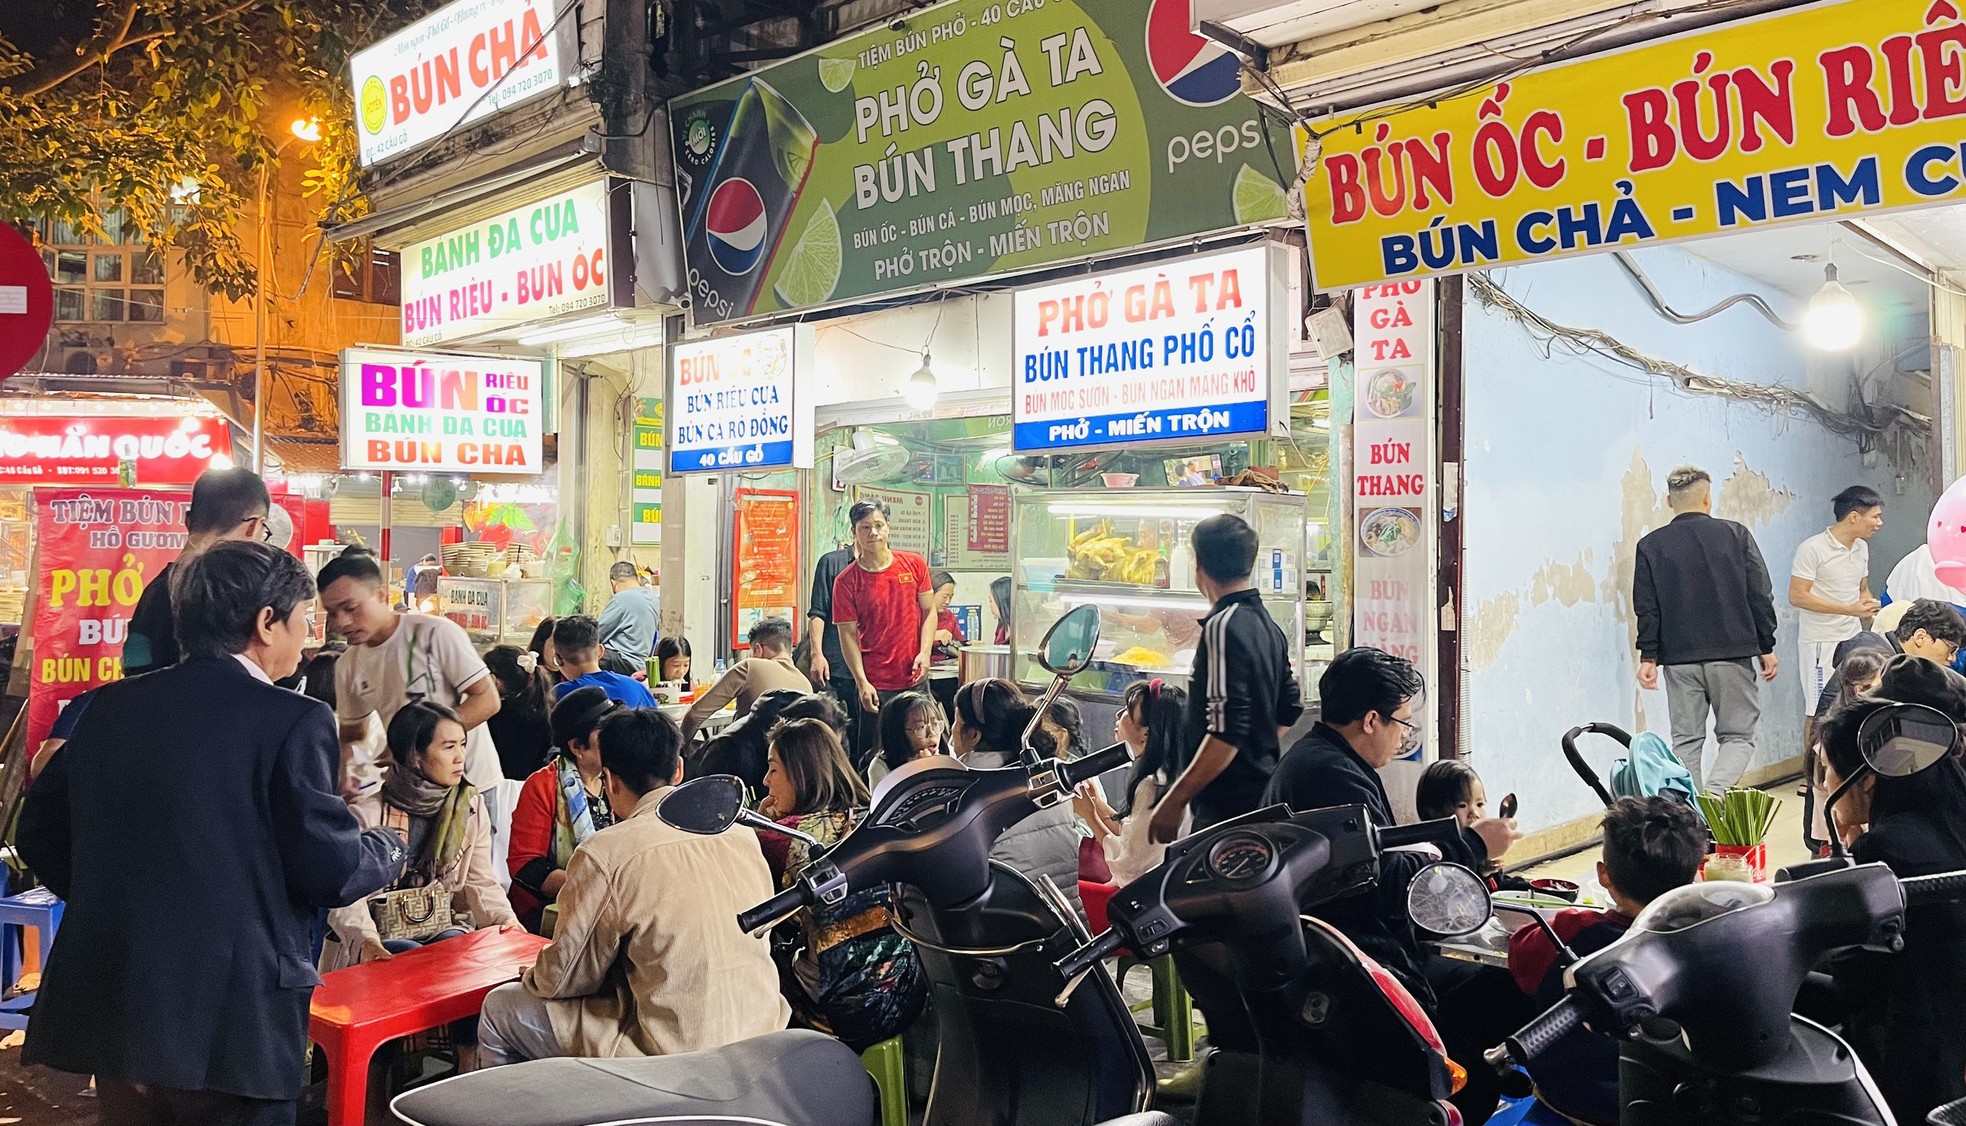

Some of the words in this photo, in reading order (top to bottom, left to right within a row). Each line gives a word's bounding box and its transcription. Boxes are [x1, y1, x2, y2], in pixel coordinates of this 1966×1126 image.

[858, 44, 891, 70] TIỆM
[896, 31, 927, 57] BÚN
[932, 11, 967, 43] PHỞ
[981, 4, 1001, 25] 40
[390, 47, 462, 126] BÚN
[468, 0, 549, 89] CHẢ
[502, 85, 517, 100] 094
[518, 79, 532, 94] 720
[533, 68, 553, 90] 3070
[854, 60, 944, 143] PHỞ
[956, 36, 1031, 111] GÀ
[1041, 26, 1103, 88] TA
[1324, 122, 1454, 226] BÚN
[1472, 82, 1566, 198] ỐC
[1623, 50, 1794, 173] BÚN
[854, 142, 936, 210] BÚN
[945, 99, 1118, 186] THANG
[853, 227, 877, 249] BÚN
[881, 220, 897, 243] ỐC
[909, 214, 935, 237] BÚN
[938, 207, 956, 230] CÁ
[969, 199, 996, 223] BÚN
[1000, 192, 1038, 217] MỌC,
[1041, 181, 1084, 207] MĂNG
[1088, 170, 1130, 197] NGAN
[1381, 215, 1500, 277] BÚN
[1514, 180, 1656, 252] CHẢ
[1715, 157, 1881, 227] NEM
[1905, 141, 1966, 196] C
[421, 235, 480, 280] BÁNH
[487, 217, 522, 260] ĐA
[530, 198, 579, 246] CUA
[874, 246, 914, 280] PHỞ
[919, 239, 972, 273] TRỘN
[989, 218, 1041, 257] MIẾN
[1047, 210, 1109, 247] TRỘN
[404, 291, 442, 334] BÚN
[449, 276, 493, 322] RIÊU
[517, 257, 563, 306] BÚN
[572, 240, 604, 291] ỐC
[1038, 280, 1113, 337] PHỞ
[1124, 273, 1175, 323] GÀ
[1188, 269, 1242, 314] TA
[549, 305, 561, 316] Tel:
[561, 301, 575, 313] 094
[575, 297, 588, 310] 720
[589, 293, 606, 306] 3070
[1370, 300, 1413, 329] GÀ
[1025, 346, 1068, 383] BÚN
[1077, 338, 1153, 376] THANG
[1164, 317, 1214, 366] PHỐ
[1225, 310, 1256, 359] CỔ
[1371, 338, 1412, 360] TA
[485, 372, 529, 390] RIÊU
[680, 350, 720, 386] BÚN
[362, 360, 478, 411] BÚN
[687, 389, 712, 413] BÚN
[717, 385, 747, 410] RIÊU
[751, 385, 779, 405] CUA
[1025, 389, 1047, 414] BÚN
[1150, 378, 1184, 401] NGAN
[1233, 365, 1255, 393] KHÔ
[486, 392, 529, 414] ỐC
[365, 410, 433, 434] BÁNH
[443, 416, 474, 436] ĐA
[483, 417, 527, 438] CUA
[678, 420, 703, 444] BÚN
[750, 407, 788, 437] ĐỒNG
[1048, 417, 1090, 441] PHỞ
[1108, 411, 1161, 437] MIẾN
[1167, 408, 1230, 433] TRỘN
[368, 437, 442, 463] BÚN
[456, 438, 526, 465] CHẢ
[699, 453, 715, 467] 40
[1370, 438, 1410, 464] BÚN
[92, 466, 107, 475] 520
[635, 473, 661, 487] BÁNH
[1357, 474, 1424, 496] THANG
[50, 493, 113, 529] TIỆM
[119, 495, 174, 525] BÚN
[90, 526, 122, 549] HỒ
[127, 531, 190, 550] GƯƠM
[49, 553, 145, 607] PHỞ
[1370, 574, 1408, 600] BÚN
[78, 614, 128, 645] BÚ
[1363, 611, 1418, 634] NGAN
[42, 653, 91, 683] BÚN
